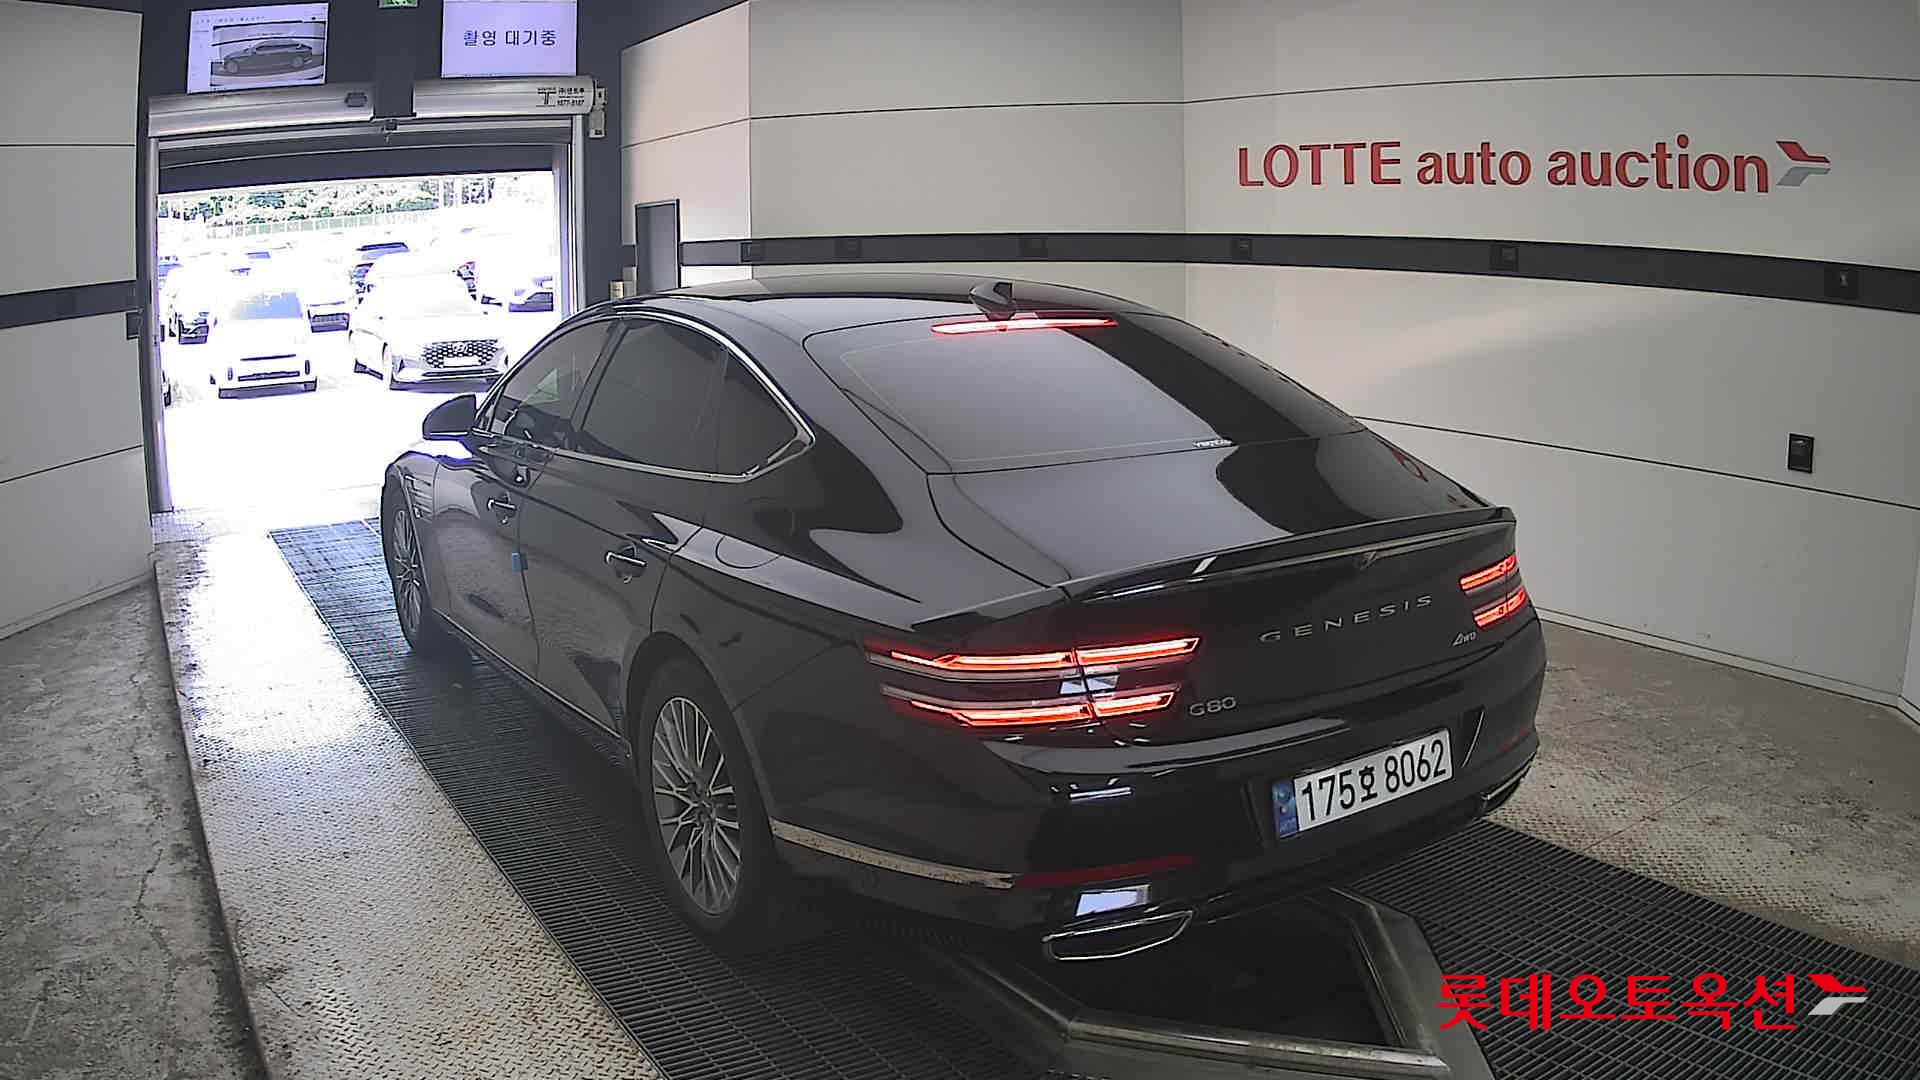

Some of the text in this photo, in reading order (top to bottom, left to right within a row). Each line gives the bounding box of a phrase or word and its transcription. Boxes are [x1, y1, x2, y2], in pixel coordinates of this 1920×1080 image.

[464, 30, 557, 47] 촬영 대기중
[1238, 133, 1769, 194] LOTTE auto auction
[1259, 594, 1433, 643] GENESIS
[1188, 695, 1238, 718] G80
[1301, 739, 1447, 821] 175호 8062
